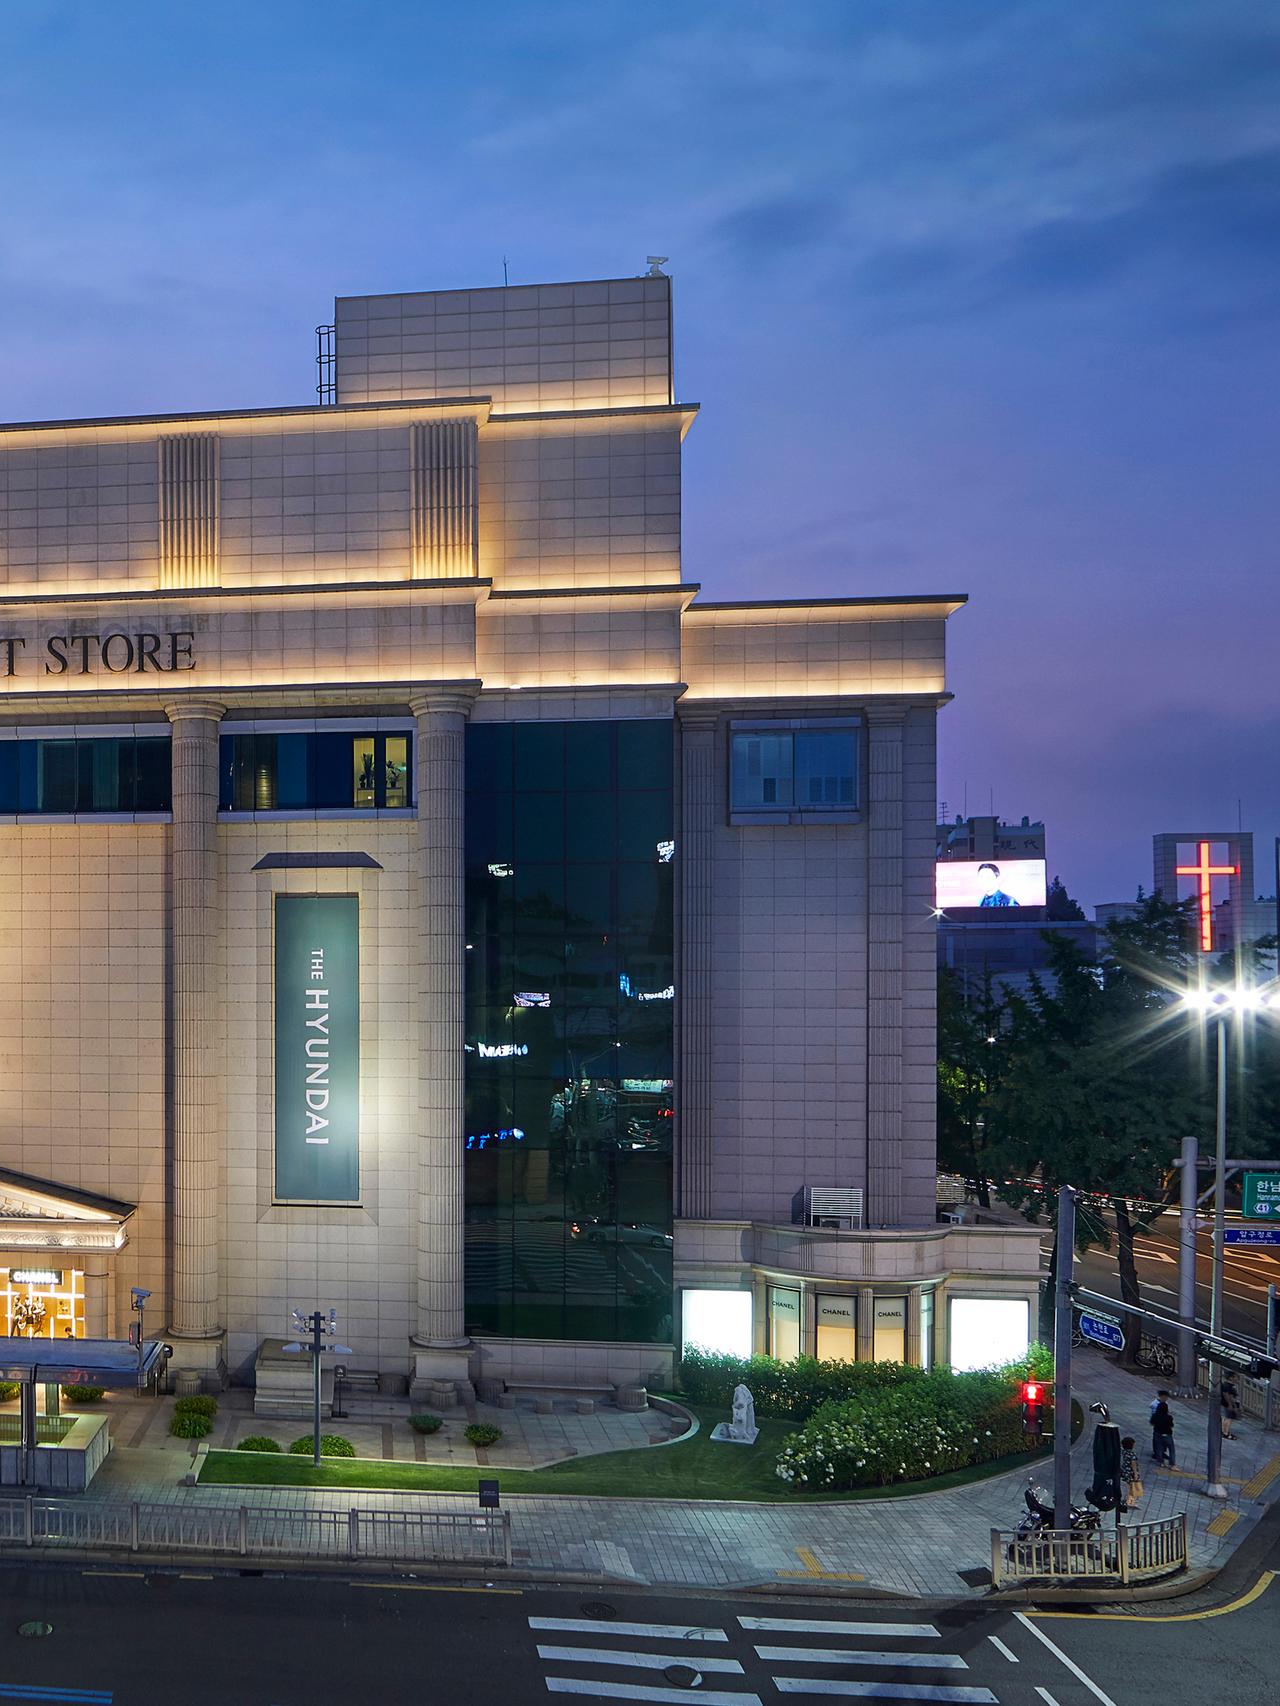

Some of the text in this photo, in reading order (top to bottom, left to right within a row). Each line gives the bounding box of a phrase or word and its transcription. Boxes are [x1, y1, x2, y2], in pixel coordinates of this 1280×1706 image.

[45, 631, 196, 675] STORE
[305, 948, 329, 1144] THE HYUNDAI
[1239, 1231, 1273, 1239] 압구정로
[13, 1271, 59, 1284] CHANEL
[771, 1300, 795, 1310] CHANEL
[822, 1308, 851, 1316] CHANEL
